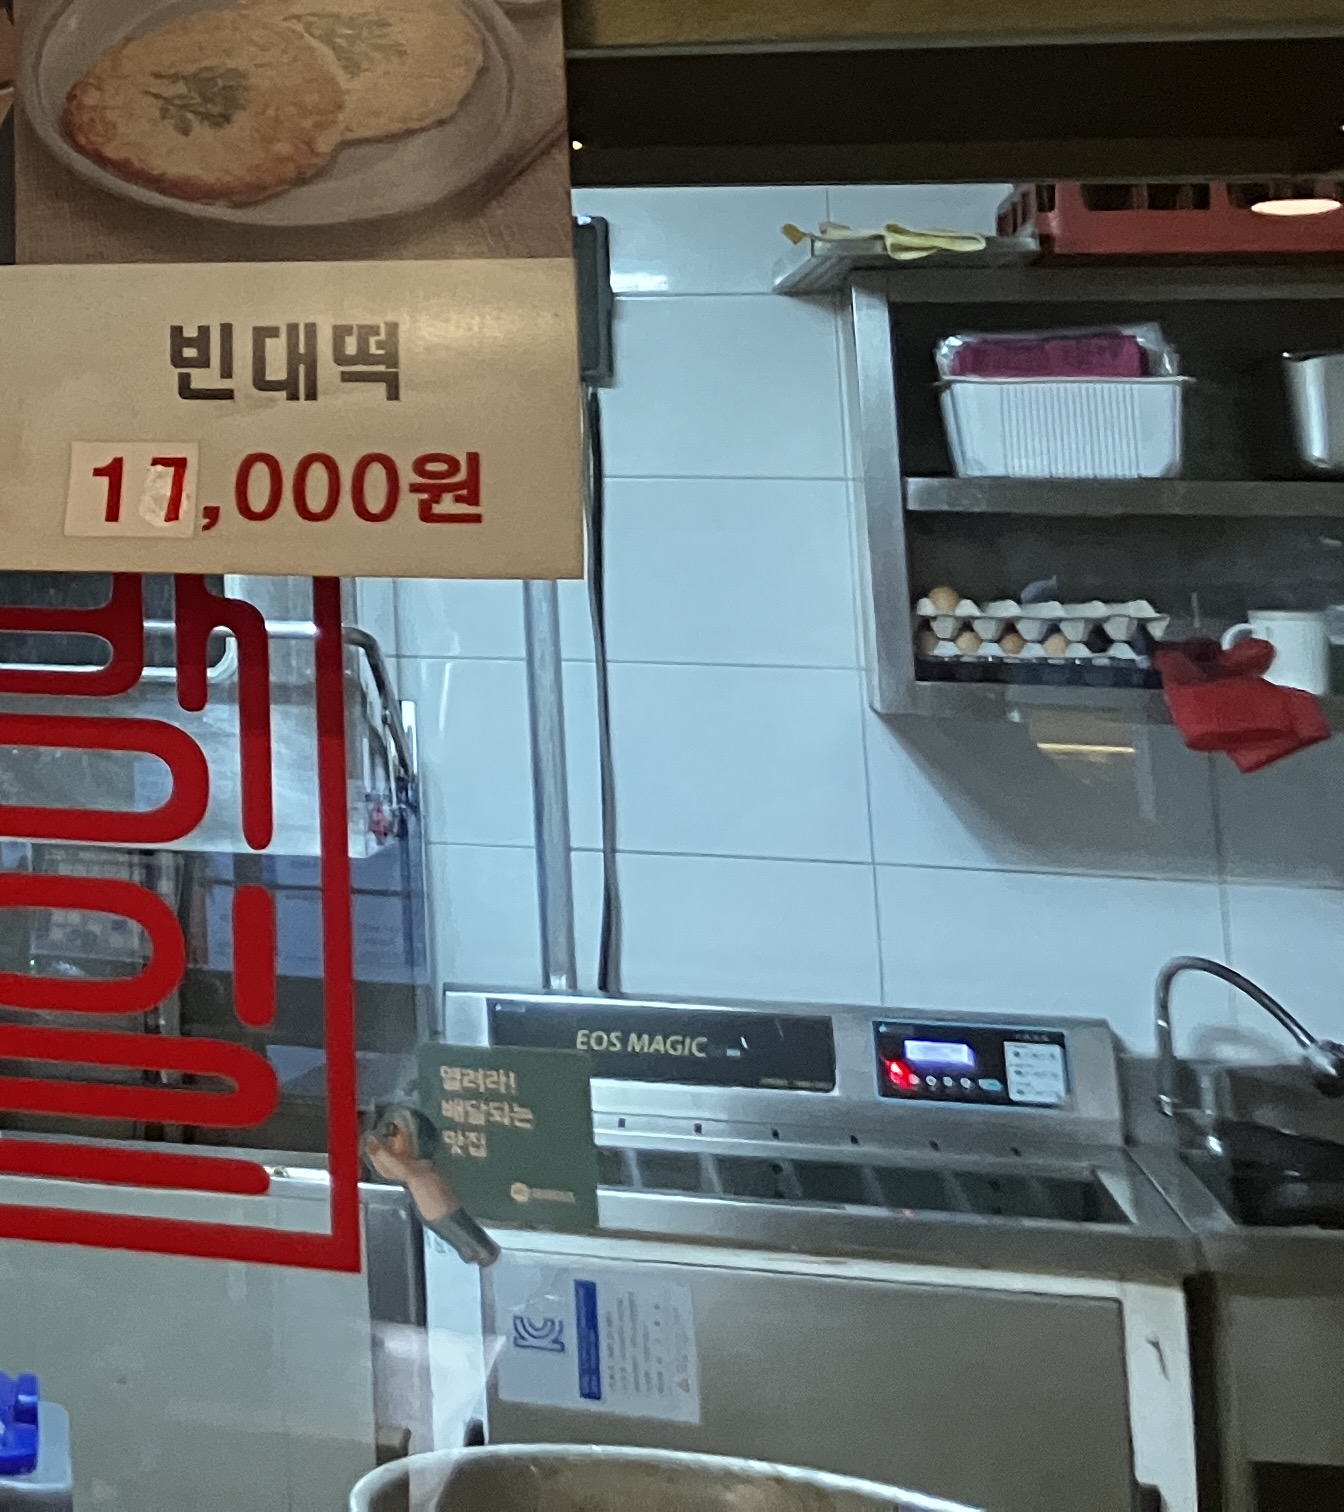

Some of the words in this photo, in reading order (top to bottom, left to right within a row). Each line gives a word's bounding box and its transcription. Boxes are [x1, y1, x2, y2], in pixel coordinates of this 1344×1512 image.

[168, 320, 401, 402] 빈대떡
[91, 450, 484, 532] 17,000원
[576, 1029, 622, 1052] EOS
[627, 1032, 708, 1058] MAGIC
